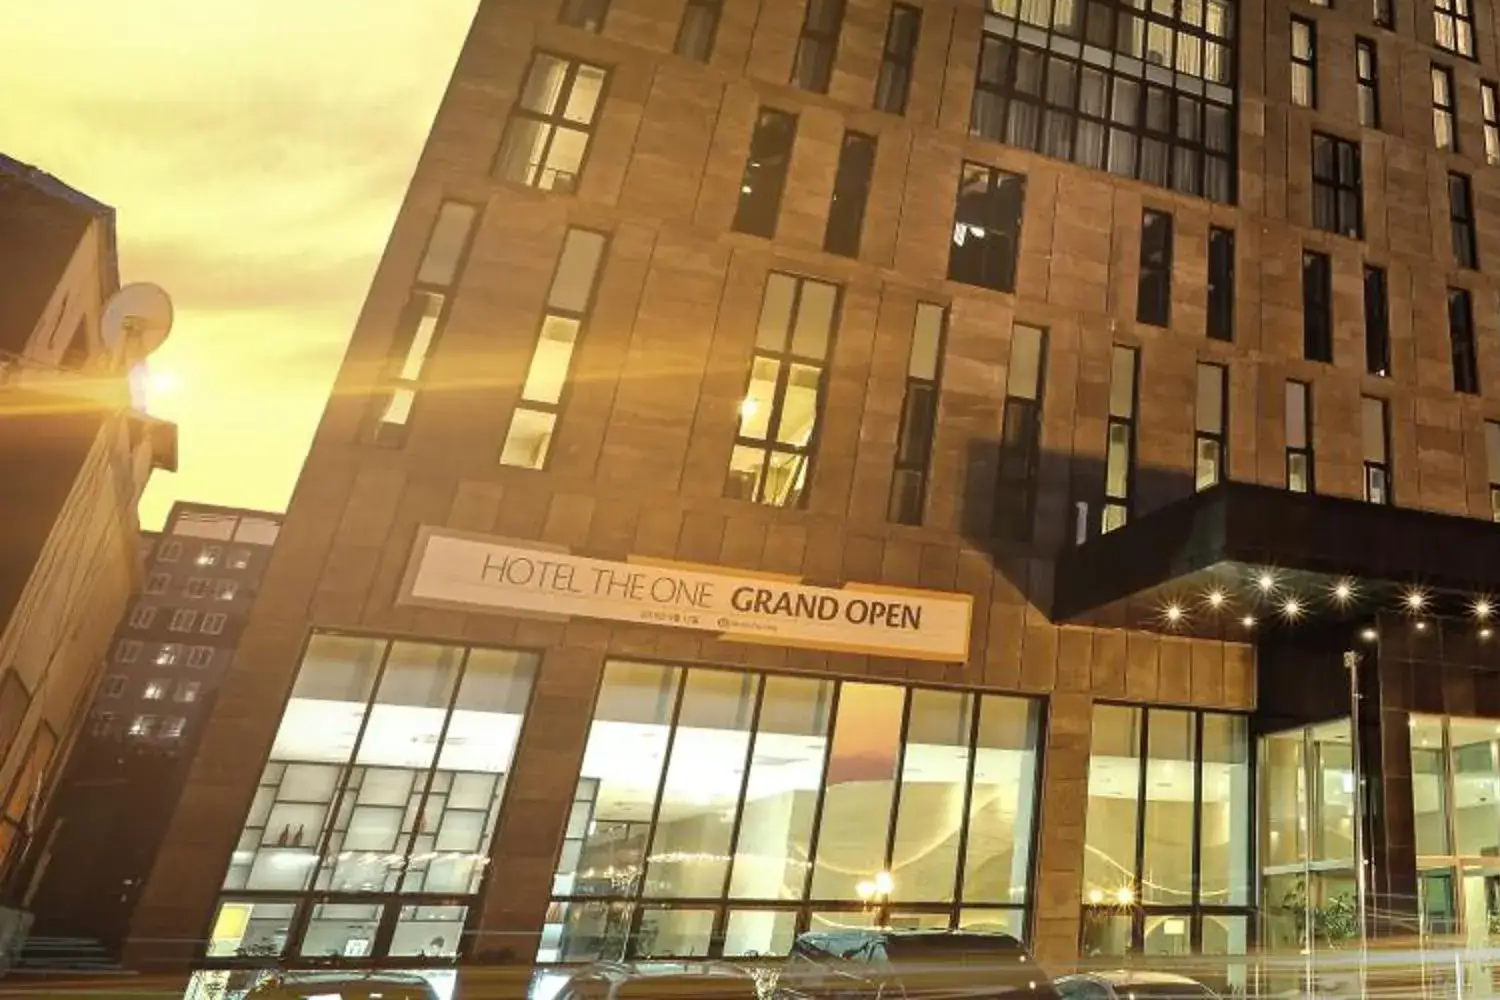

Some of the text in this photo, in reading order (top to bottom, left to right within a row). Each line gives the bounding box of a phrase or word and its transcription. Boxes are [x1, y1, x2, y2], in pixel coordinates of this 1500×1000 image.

[481, 553, 922, 631] HOTEL THE ONE GRAND OPEN
